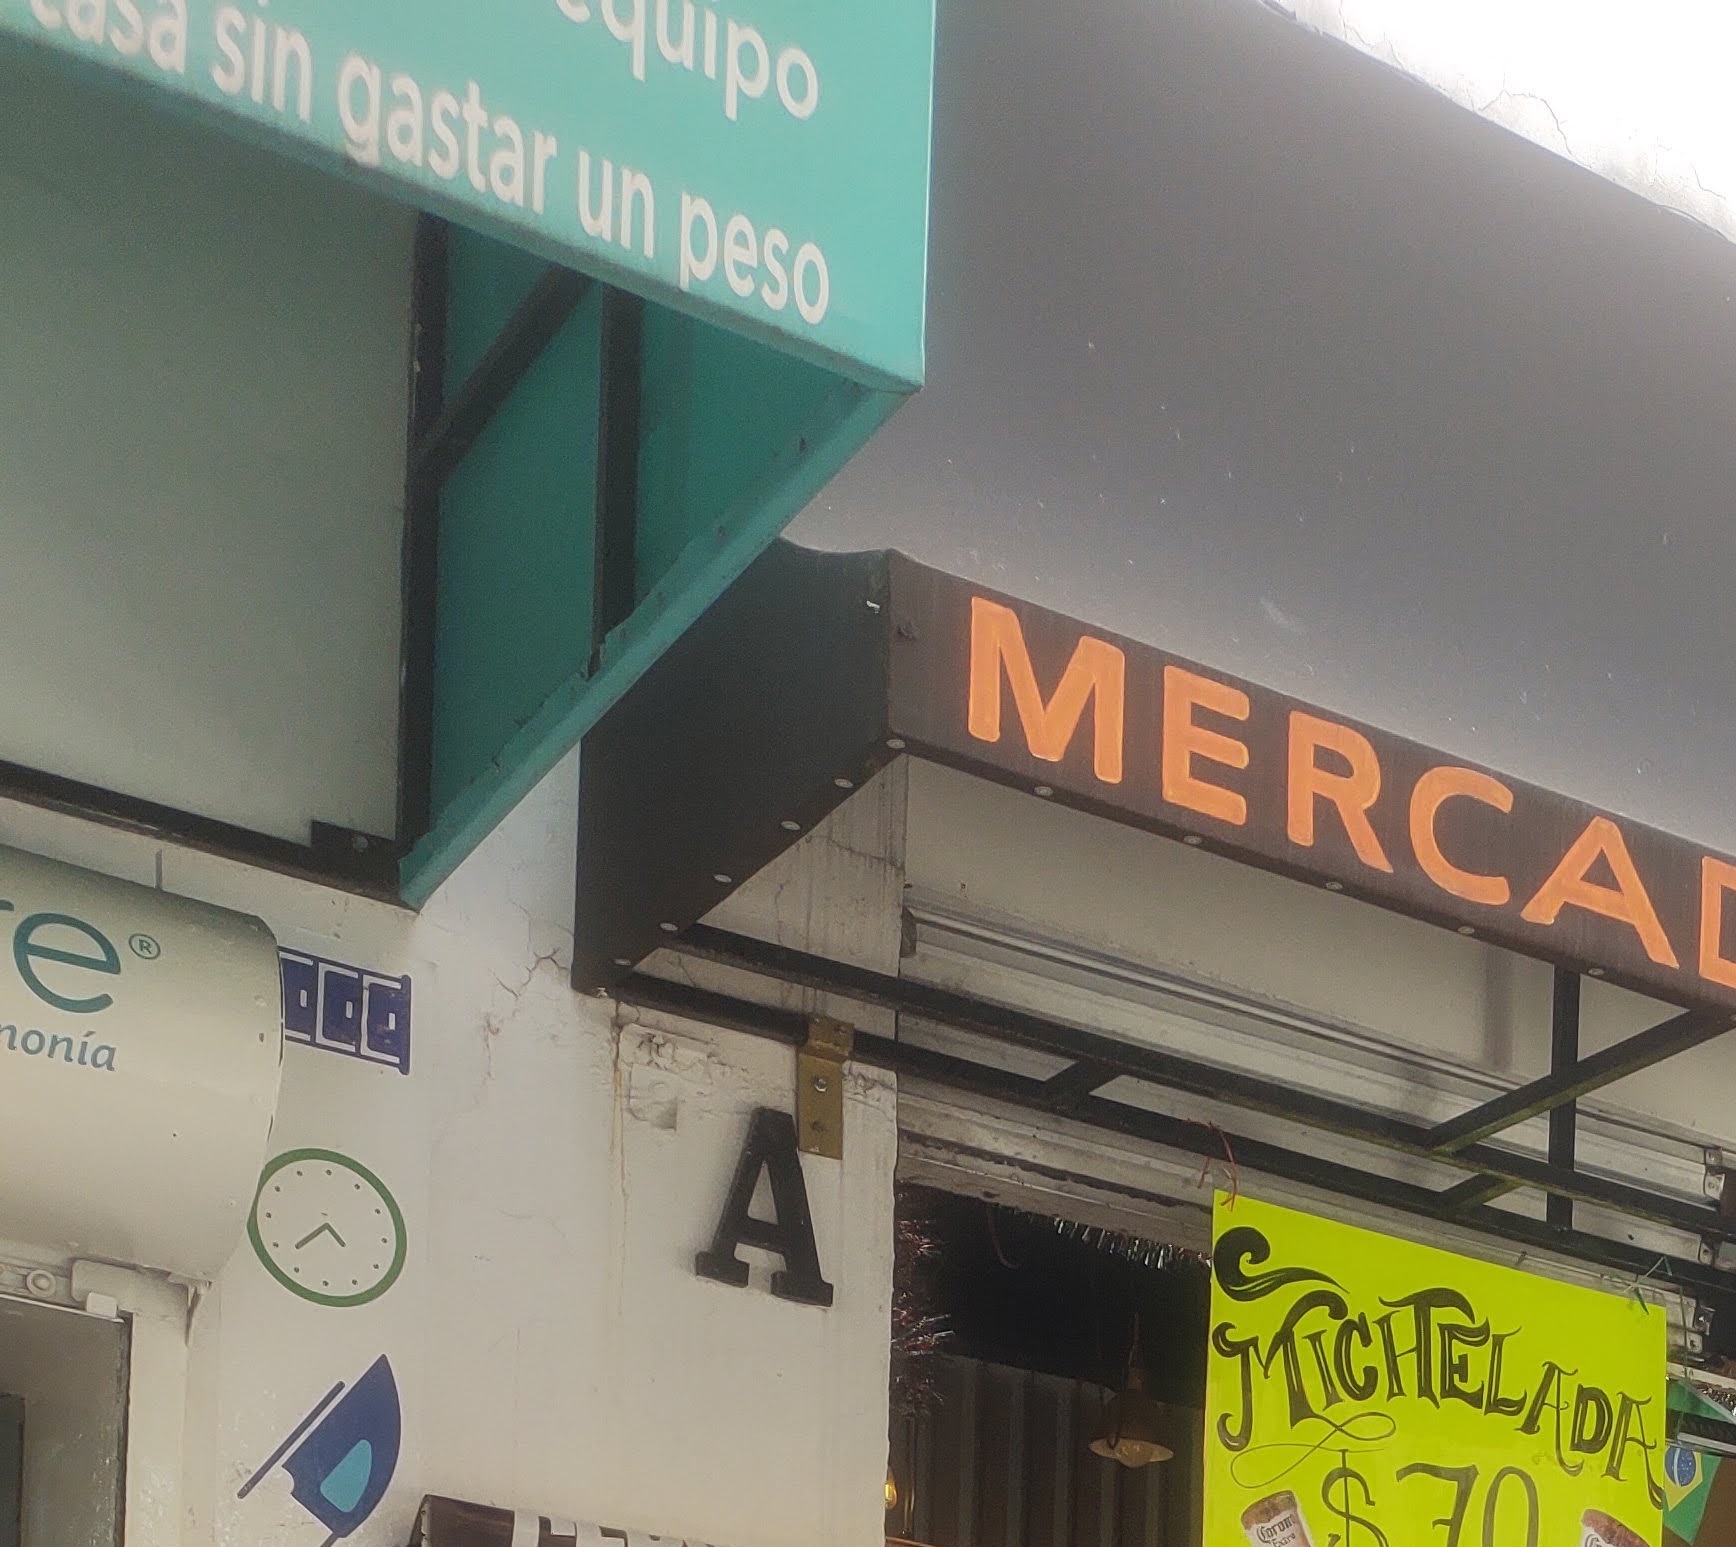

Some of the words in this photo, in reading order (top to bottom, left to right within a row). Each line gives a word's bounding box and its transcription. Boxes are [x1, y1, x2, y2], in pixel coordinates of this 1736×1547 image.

[212, 0, 314, 124] sin
[338, 52, 558, 216] gastar
[577, 146, 655, 258] un
[678, 189, 830, 325] peso
[695, 1105, 833, 1308] A
